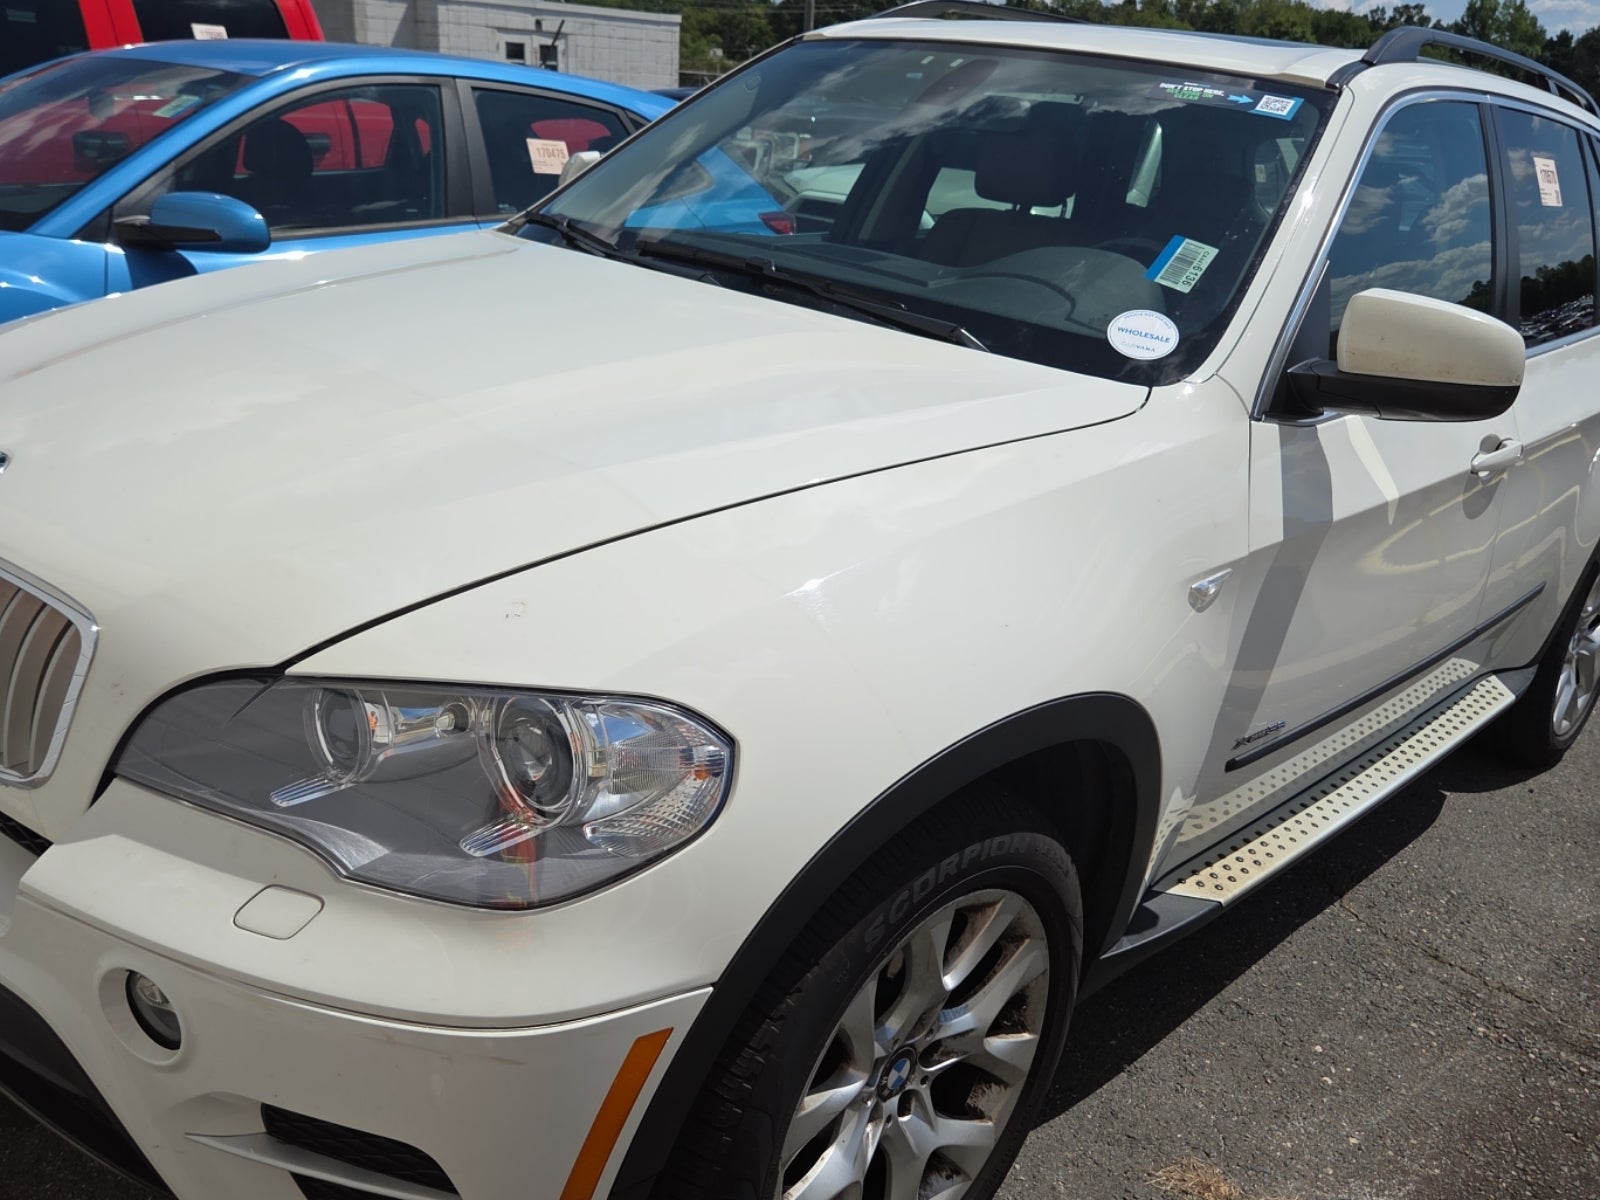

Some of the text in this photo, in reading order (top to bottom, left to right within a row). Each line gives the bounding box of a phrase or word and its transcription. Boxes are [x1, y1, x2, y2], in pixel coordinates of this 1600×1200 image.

[536, 148, 566, 160] 170475
[1117, 326, 1171, 343] WHOLESALE
[863, 835, 1025, 953] SCORPION
